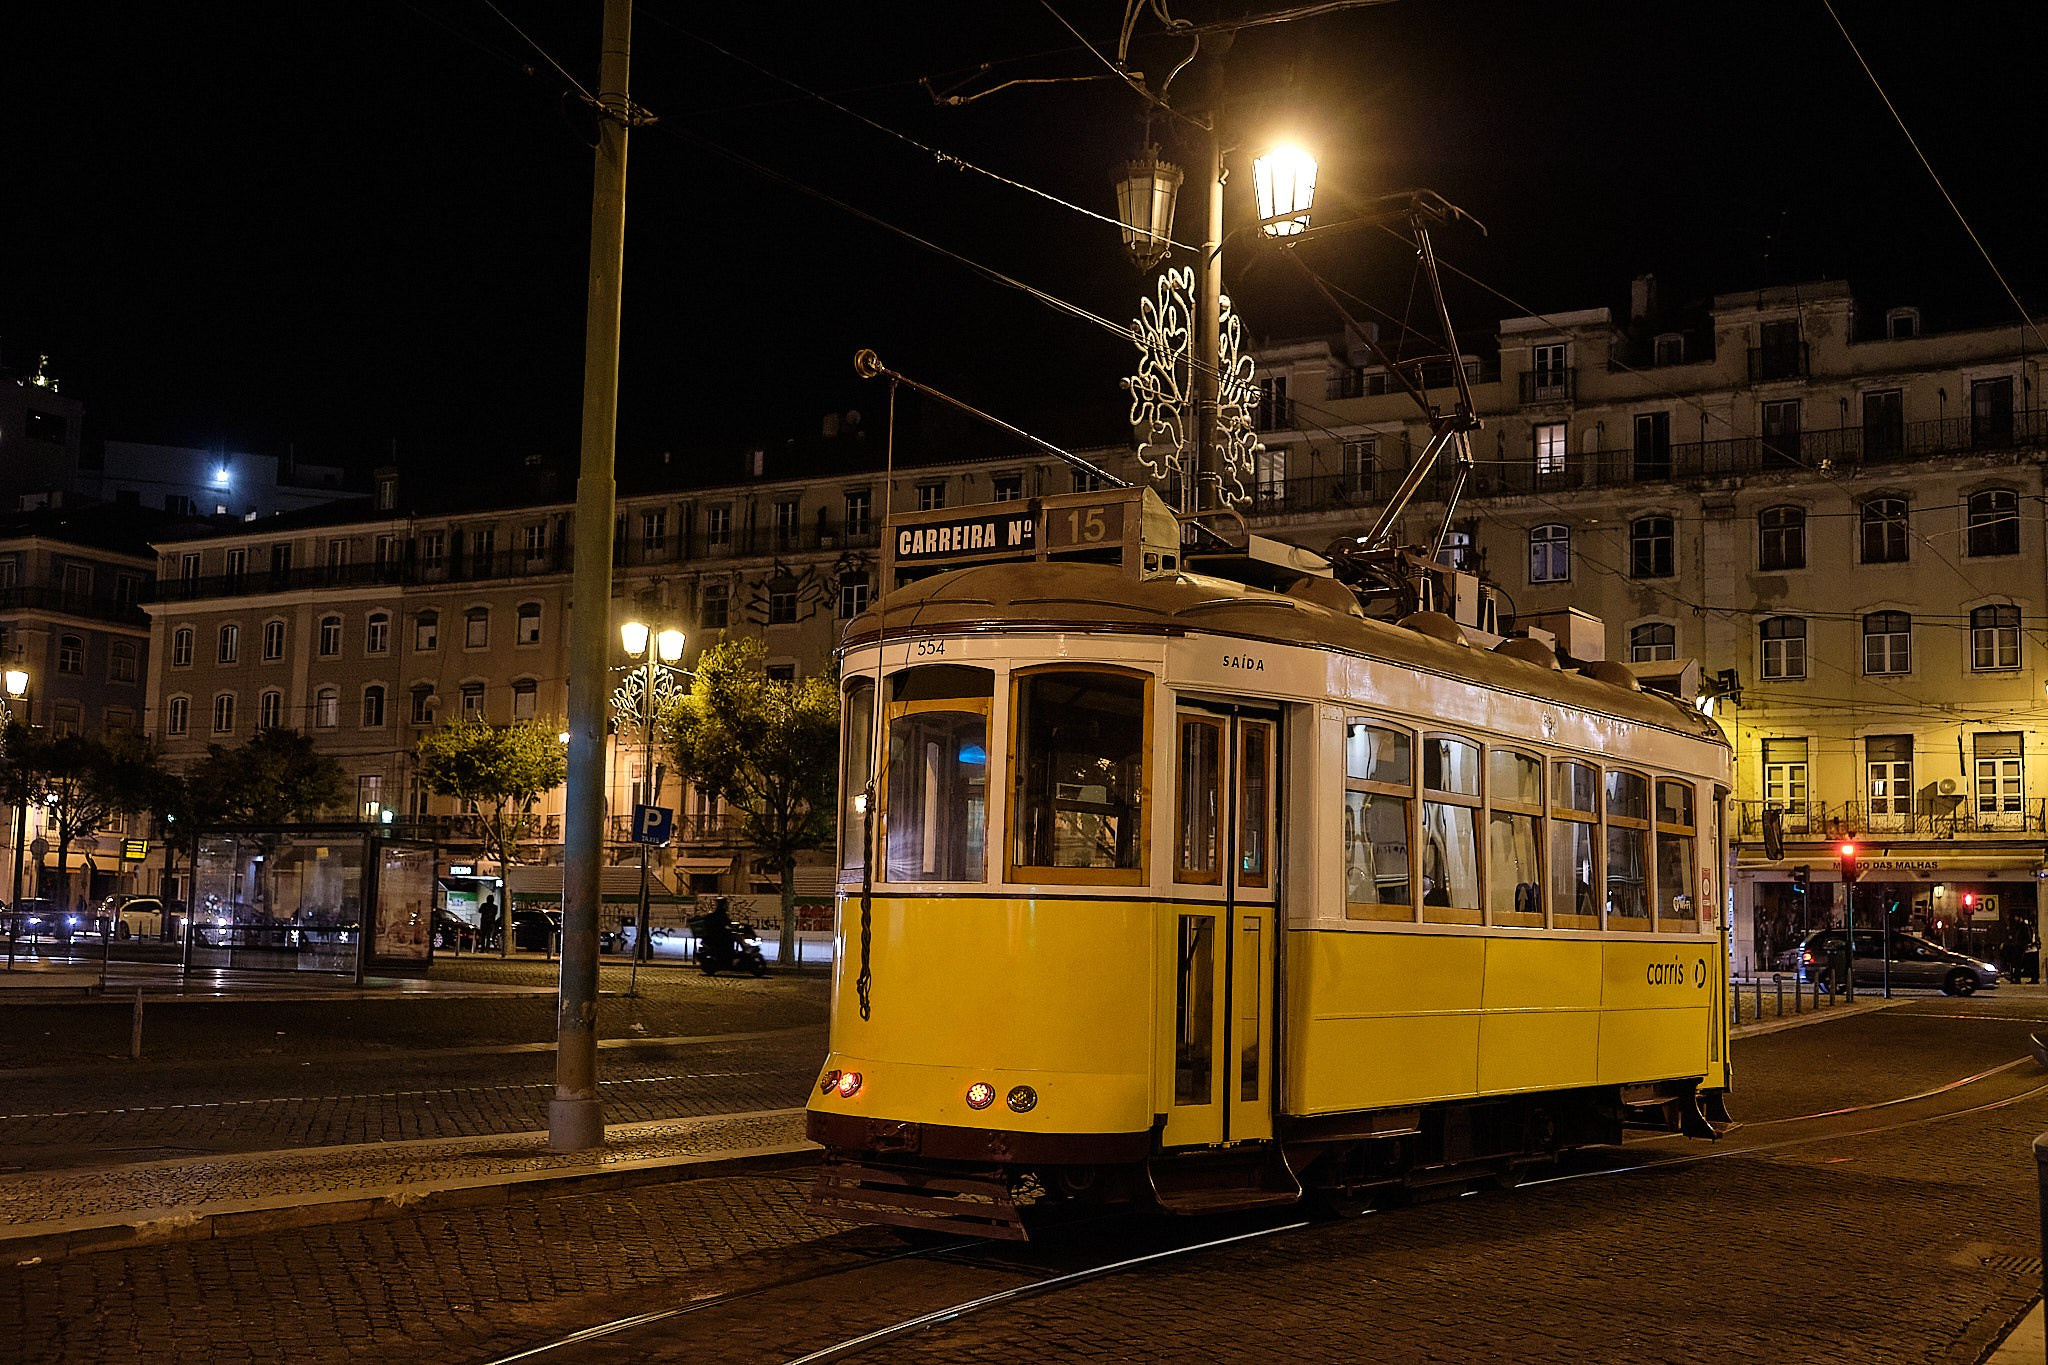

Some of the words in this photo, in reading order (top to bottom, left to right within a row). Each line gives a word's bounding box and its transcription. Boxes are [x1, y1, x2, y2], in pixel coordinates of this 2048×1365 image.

[1068, 507, 1106, 543] 15
[898, 522, 996, 555] CARREIRA
[917, 639, 946, 656] 554
[1222, 654, 1265, 672] SAÍDA
[642, 808, 662, 834] P
[1873, 861, 1893, 869] DAS
[1895, 861, 1938, 869] MALHAS
[1646, 955, 1684, 986] carris
